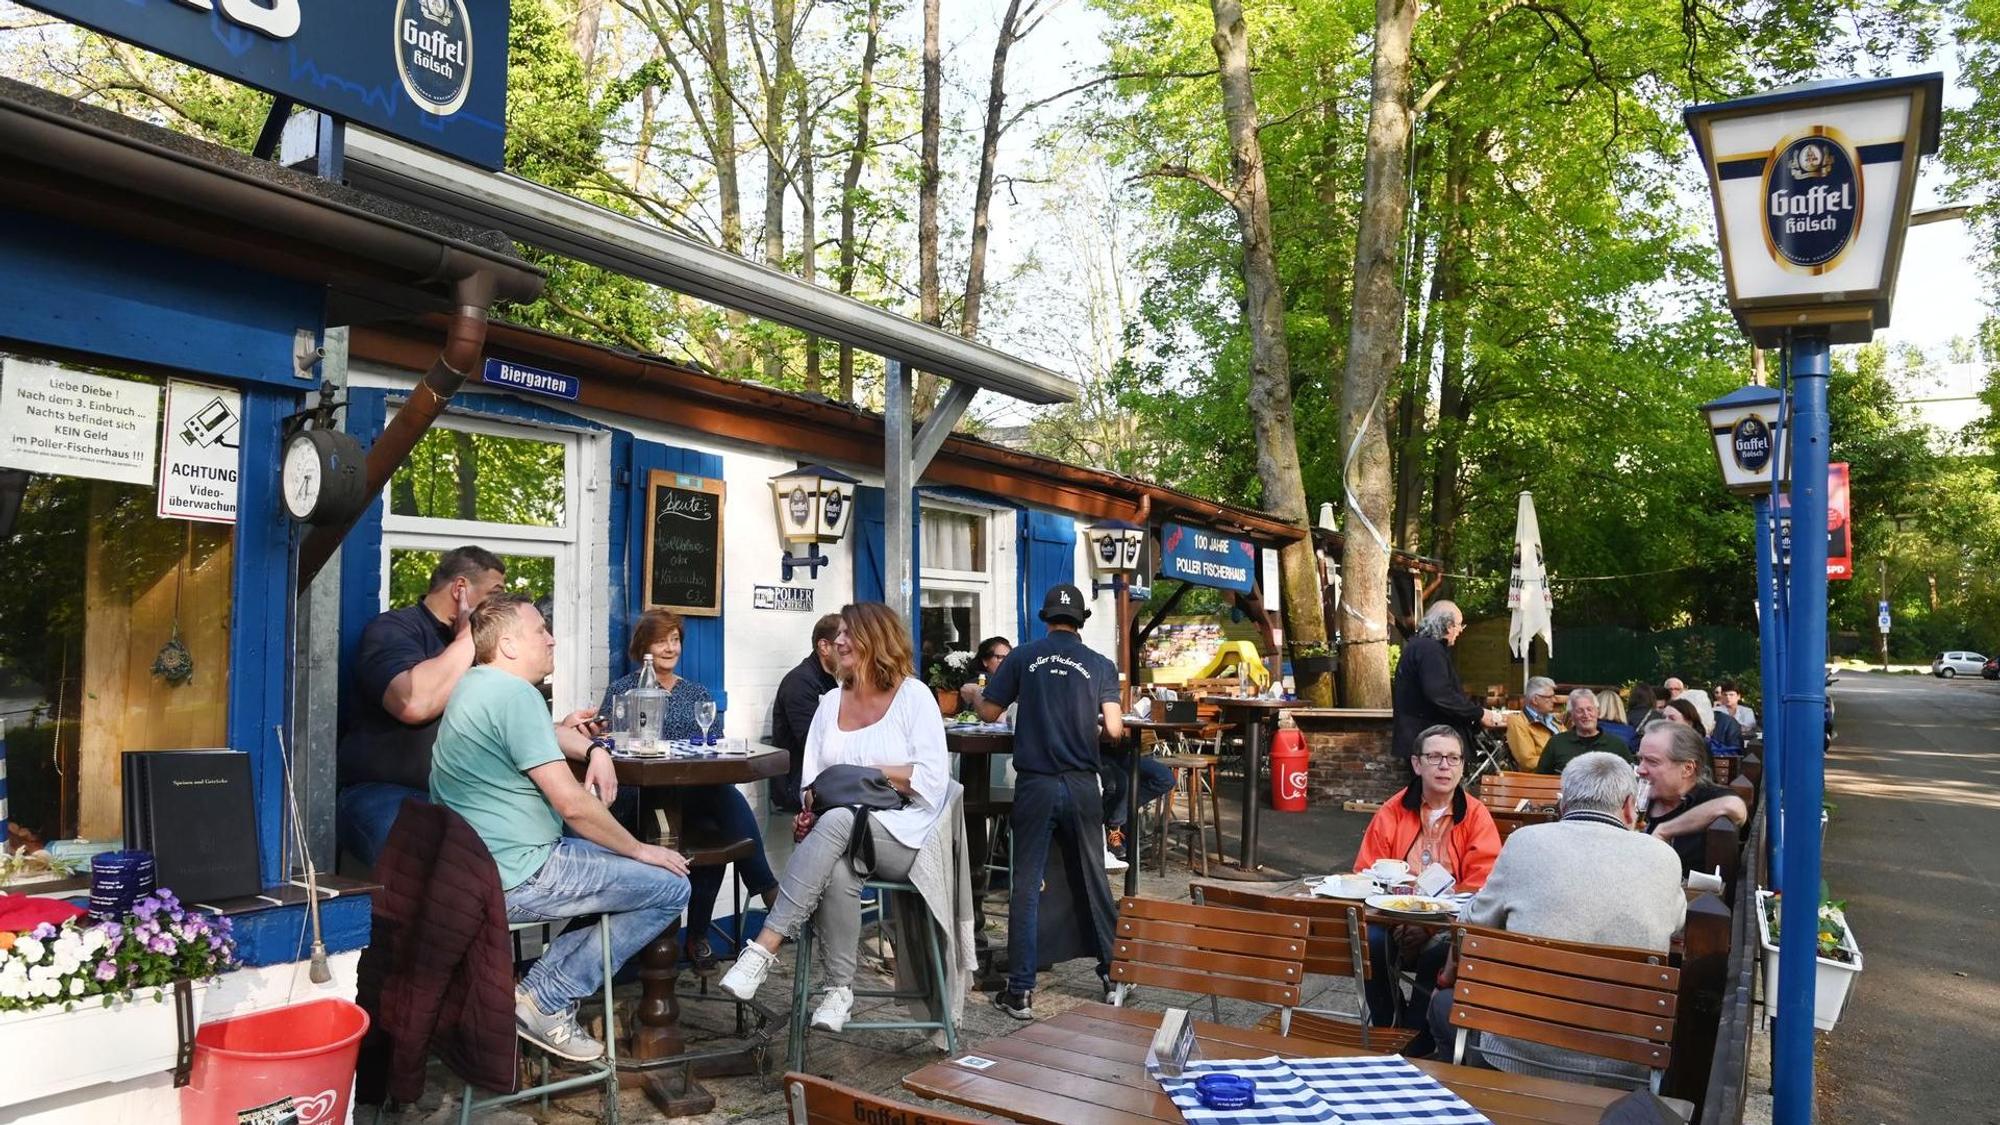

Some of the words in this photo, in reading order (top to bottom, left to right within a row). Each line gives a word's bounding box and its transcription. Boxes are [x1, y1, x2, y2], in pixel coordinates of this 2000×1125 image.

[403, 18, 465, 66] Gaffel
[413, 50, 453, 80] Kölsch
[1771, 183, 1853, 217] Gaffel
[1785, 214, 1837, 234] Kölsch
[500, 364, 567, 393] Biergarten
[49, 379, 79, 393] Liebe
[81, 383, 113, 399] Diebe
[17, 388, 46, 402] Nach
[48, 393, 73, 407] dem
[76, 398, 86, 408] 3.
[89, 401, 135, 418] Einbruch
[26, 405, 65, 420] Nachts
[68, 411, 113, 429] befindet
[115, 419, 136, 431] sich
[54, 425, 80, 438] KEIN
[83, 429, 108, 441] Geld
[30, 436, 130, 460] Poller-Fischerhaus
[1736, 437, 1769, 451] Gaffel
[171, 463, 237, 483] ACHTUNG
[189, 484, 224, 498] Video-
[169, 497, 237, 513] überwachun
[1194, 534, 1208, 550] 100
[1209, 538, 1230, 554] JAHRE
[1176, 557, 1201, 575] POLLER
[1203, 562, 1247, 582] FISCHERHAUS
[774, 587, 813, 601] POLLER
[1060, 590, 1071, 605] LA
